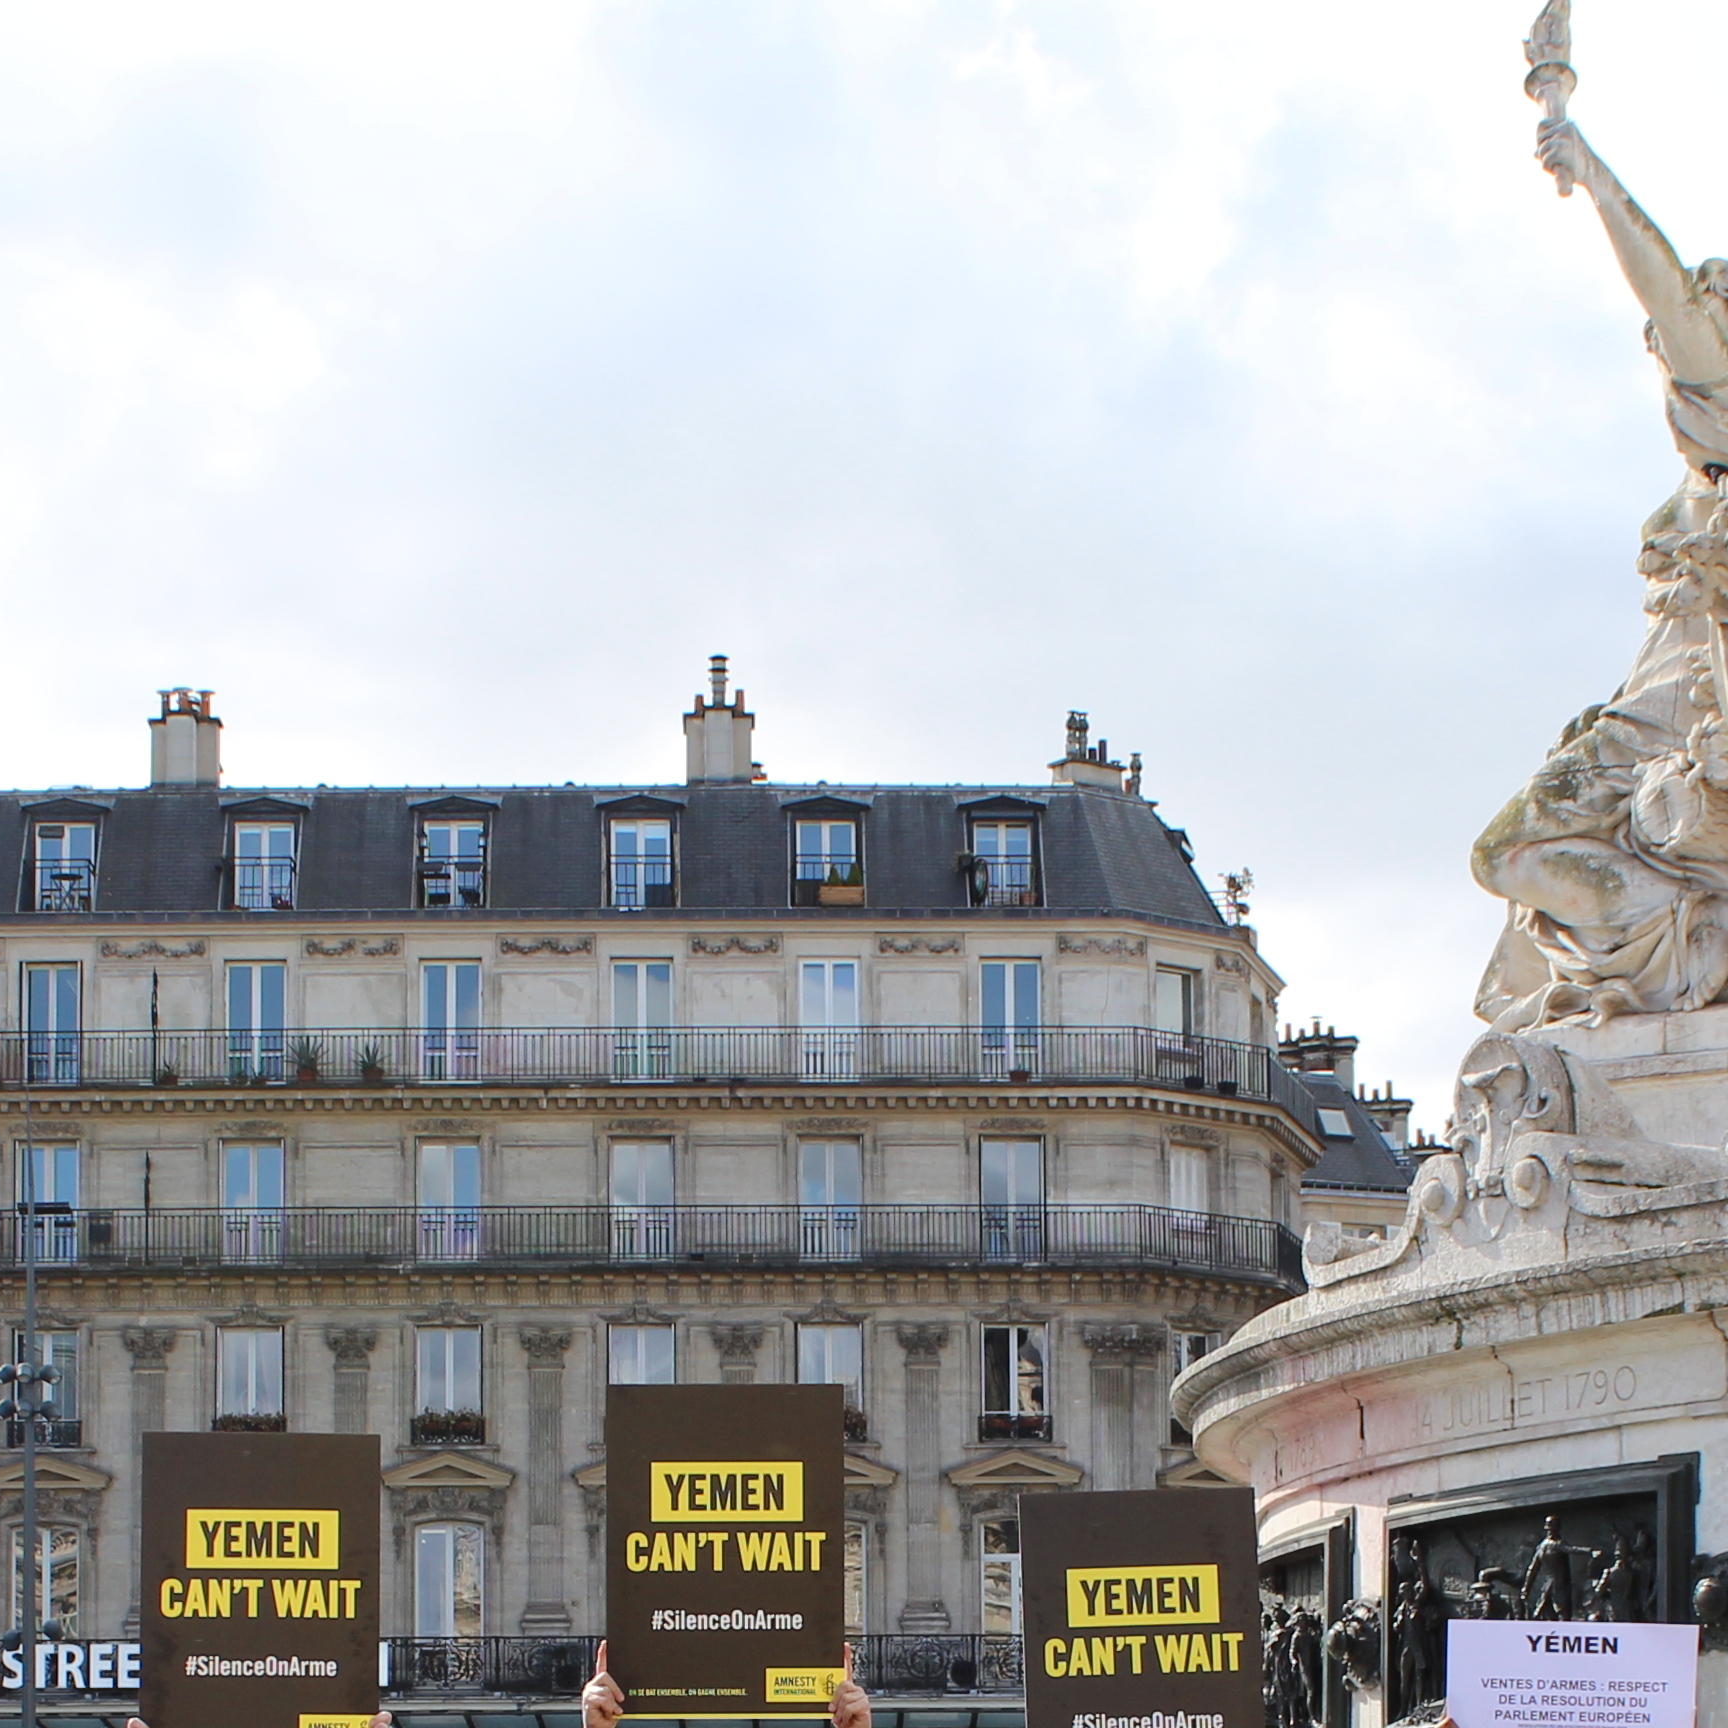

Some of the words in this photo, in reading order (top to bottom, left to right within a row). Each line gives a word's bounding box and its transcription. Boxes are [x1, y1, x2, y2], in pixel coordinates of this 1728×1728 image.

[1443, 1379, 1552, 1430] JUILLET
[1565, 1366, 1638, 1411] 1790
[663, 1473, 784, 1511] YEMEN
[199, 1520, 320, 1558] YEMEN
[626, 1531, 728, 1571] CAN'T
[736, 1531, 826, 1571] WAIT
[160, 1578, 264, 1617] CAN'T
[271, 1579, 361, 1618] WAIT
[1079, 1576, 1200, 1616] YEMEN
[651, 1609, 802, 1630] #SilenceOnArme
[1044, 1635, 1146, 1677] CAN'T
[1153, 1632, 1243, 1673] WAIT
[1526, 1630, 1618, 1654] YÉMEN
[185, 1655, 337, 1676] #SilenceOnArme
[774, 1676, 816, 1687] AMNESTY
[1480, 1677, 1533, 1690] VENTES
[1536, 1679, 1597, 1691] D'ARMES
[1607, 1680, 1668, 1692] RESPECT
[1494, 1709, 1575, 1721] PARLEMENT
[1578, 1710, 1650, 1723] EUROPÉEN
[1498, 1693, 1516, 1705] DE
[1520, 1694, 1537, 1705] LA
[1540, 1694, 1625, 1707] RESOLUTION
[1629, 1696, 1647, 1708] DU
